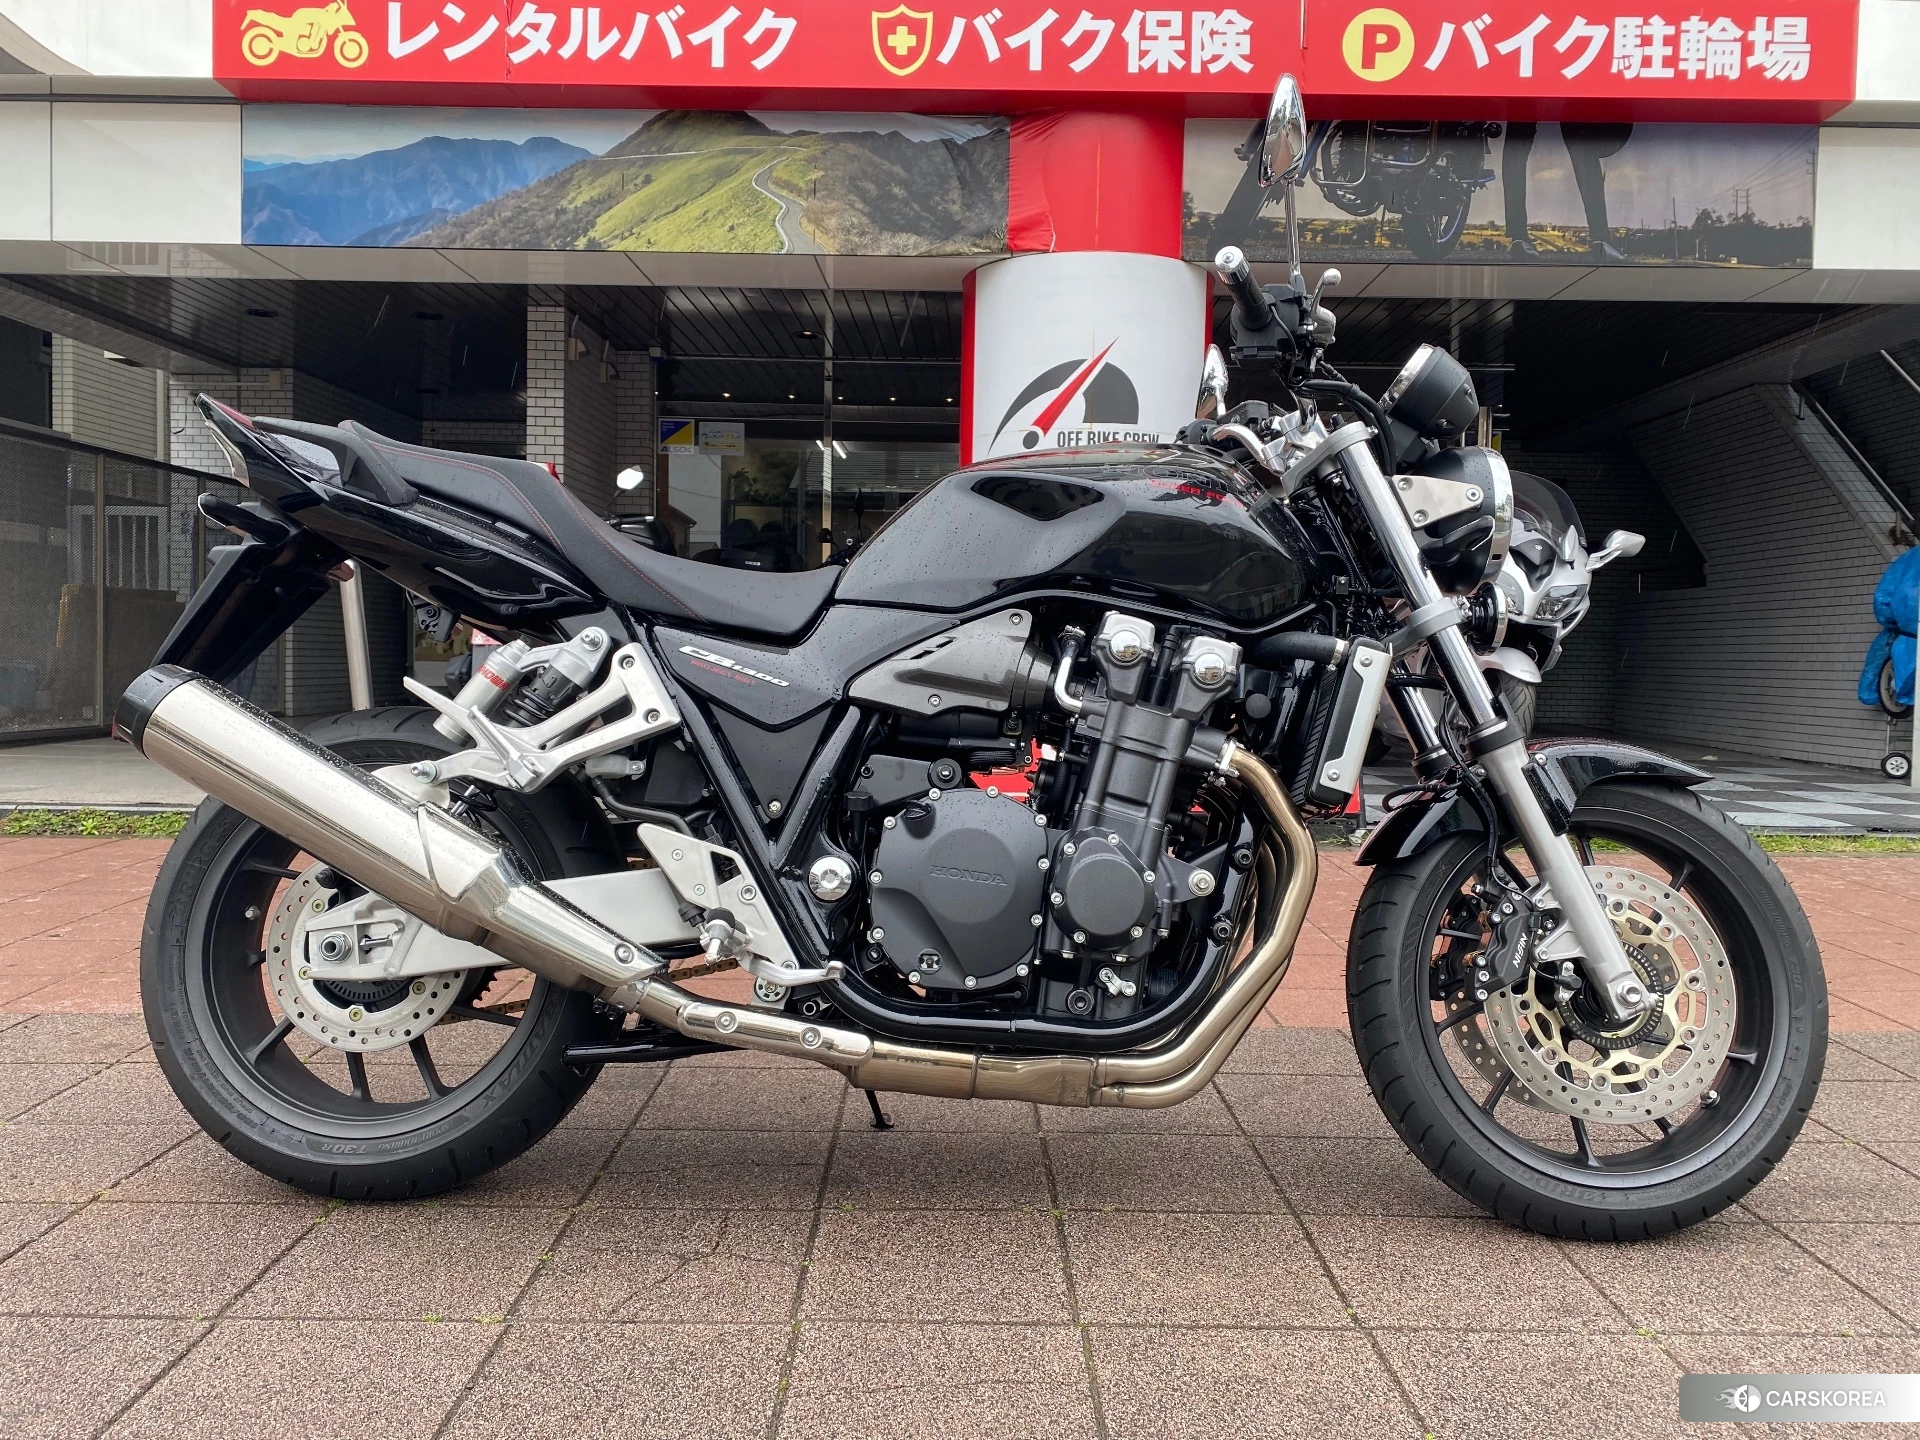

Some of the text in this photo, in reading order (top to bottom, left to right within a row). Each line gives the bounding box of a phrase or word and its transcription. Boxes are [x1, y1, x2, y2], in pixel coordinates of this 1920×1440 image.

[387, 1, 797, 69] レンタルバイク
[936, 8, 1254, 73] バイク保険
[1361, 24, 1401, 69] P
[1424, 13, 1811, 81] バイク駐輪場
[1057, 430, 1083, 448] OFF
[1087, 431, 1120, 445] BIKE
[690, 659, 731, 677] PROJECT
[930, 864, 1007, 886] HONDA
[1512, 932, 1528, 968] NISSIN
